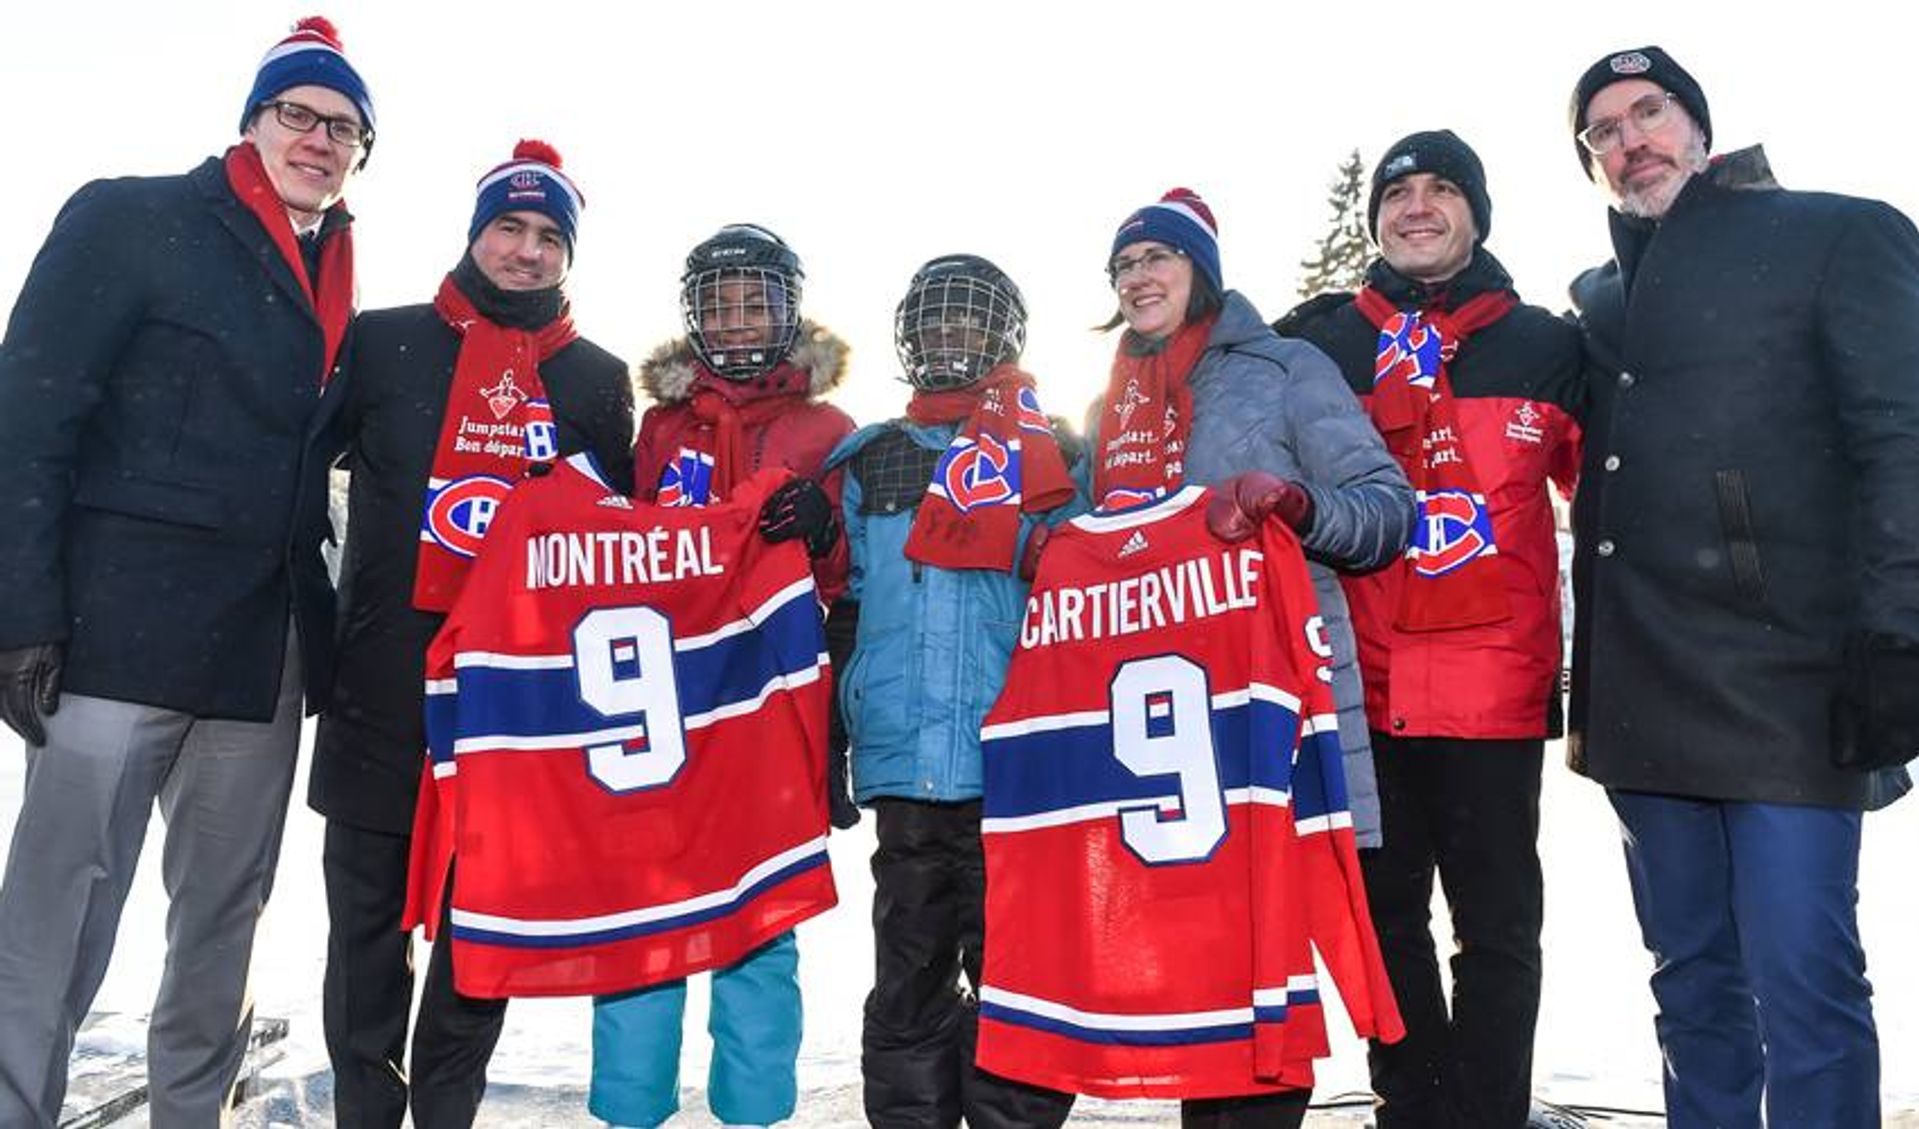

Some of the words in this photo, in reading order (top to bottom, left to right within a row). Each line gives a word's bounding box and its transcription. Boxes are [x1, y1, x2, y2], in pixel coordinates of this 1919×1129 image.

[527, 526, 723, 589] MONTRÉAL
[1020, 548, 1264, 649] CARTIERVILLE
[573, 605, 688, 796] 9
[1109, 652, 1230, 867] 9
